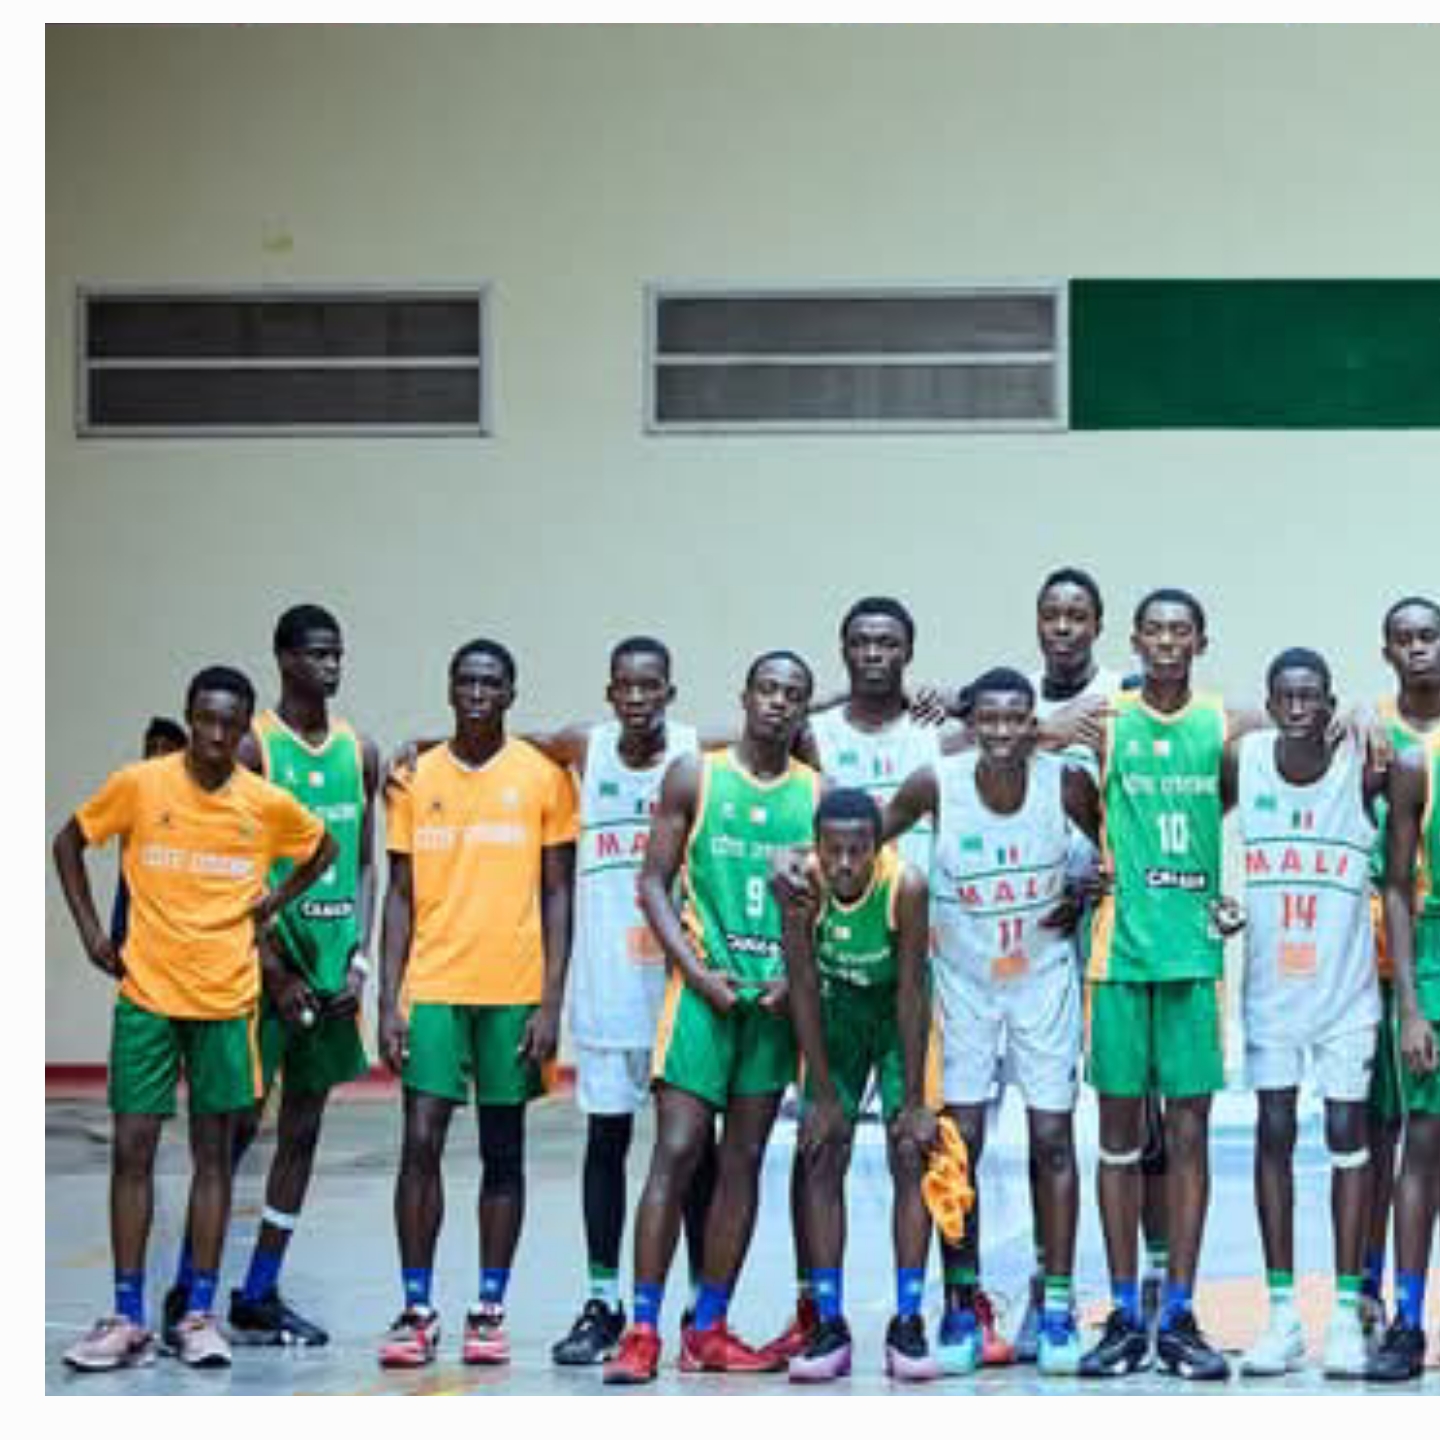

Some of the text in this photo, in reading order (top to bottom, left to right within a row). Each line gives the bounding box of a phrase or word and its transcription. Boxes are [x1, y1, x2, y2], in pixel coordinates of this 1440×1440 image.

[1156, 813, 1188, 855] 10
[1244, 847, 1349, 878] MALI
[743, 876, 765, 917] 9
[1281, 894, 1317, 929] 14
